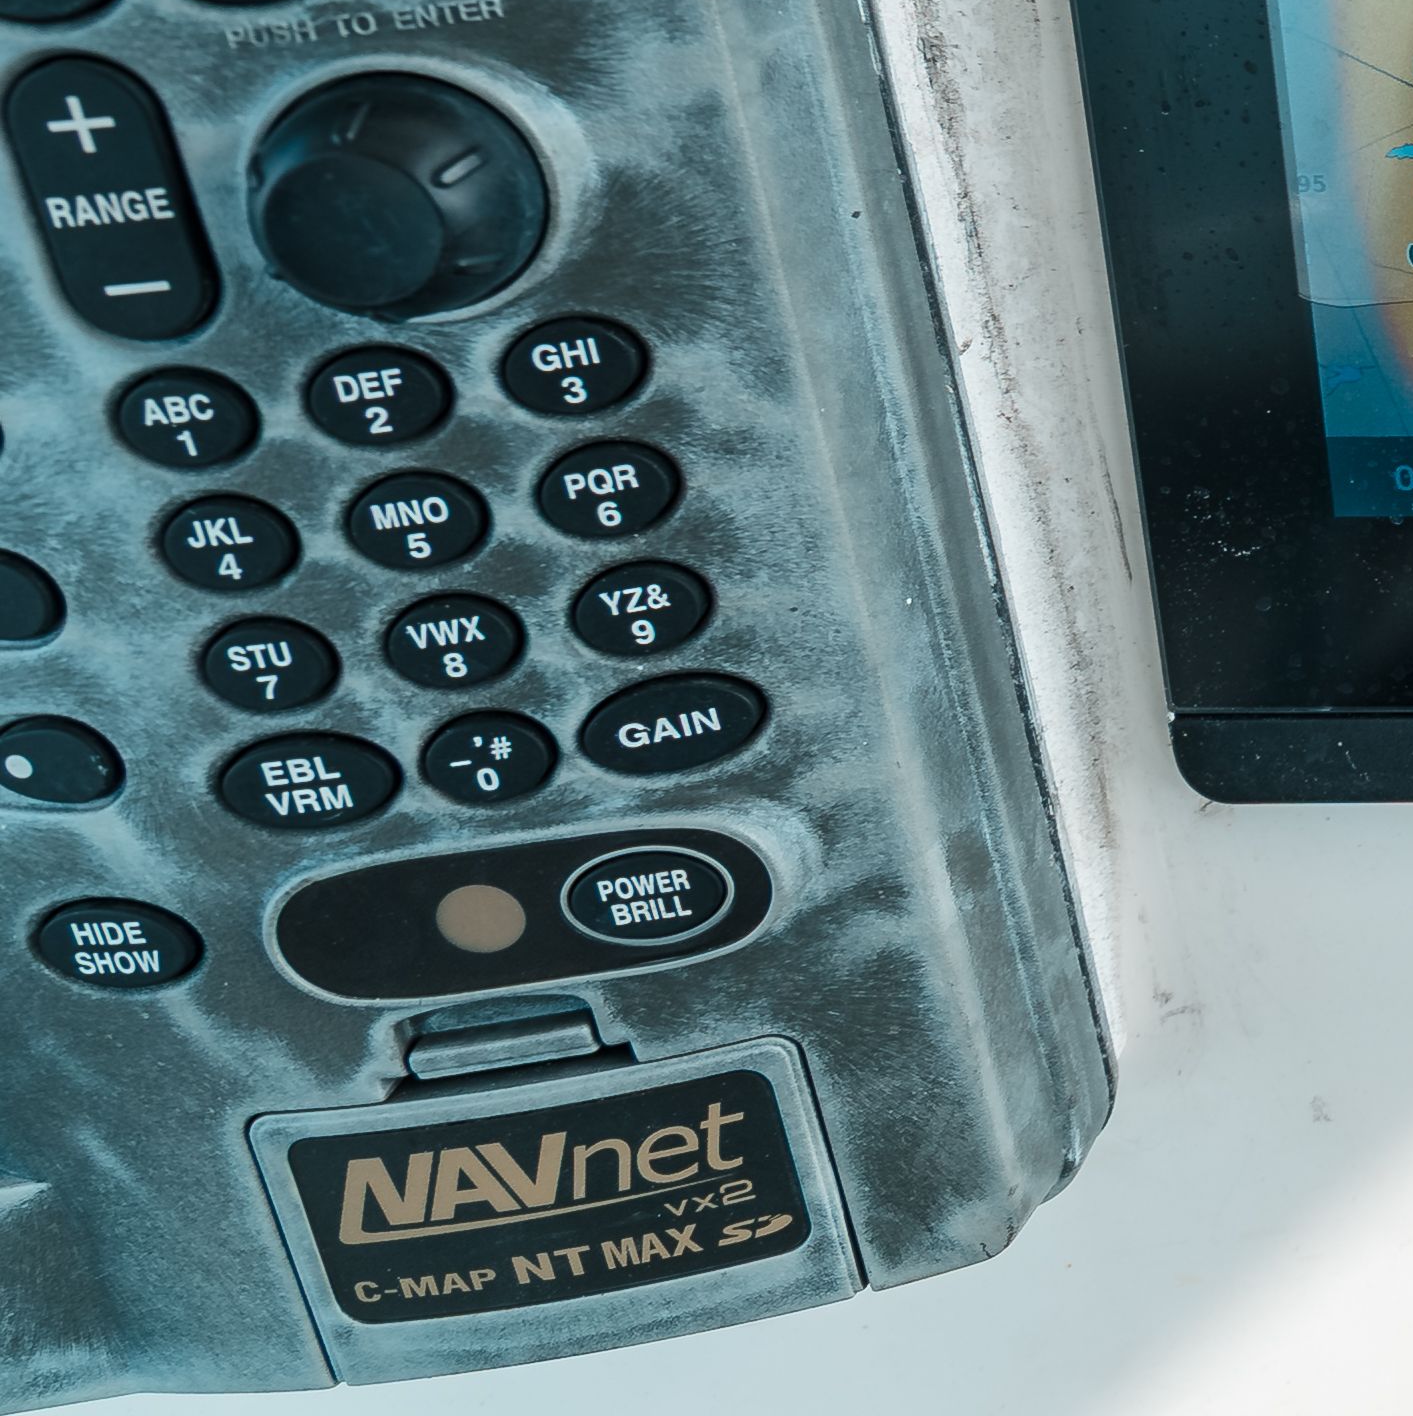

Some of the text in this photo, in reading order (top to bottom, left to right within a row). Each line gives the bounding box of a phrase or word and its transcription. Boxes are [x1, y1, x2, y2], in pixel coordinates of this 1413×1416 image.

[226, 21, 315, 48] PUSH
[336, 13, 376, 37] TO
[46, 189, 174, 229] RANGE
[532, 338, 601, 372] GHI
[333, 369, 402, 403] DEF
[562, 376, 588, 405] 3
[144, 395, 214, 427] ABC
[366, 407, 392, 435] 2
[178, 431, 199, 458] 1
[564, 464, 639, 500] PQR
[371, 496, 449, 531] MNO
[598, 501, 622, 528] 6
[188, 518, 253, 549] JKL
[408, 532, 432, 559] 5
[218, 554, 242, 580] 4
[600, 584, 671, 615] YZ&
[406, 616, 485, 650] VWX
[631, 620, 656, 645] 9
[228, 642, 292, 673] STU
[442, 653, 468, 678] 8
[256, 675, 278, 701] 7
[617, 707, 723, 749] GAIN
[261, 755, 342, 787] EBL
[476, 766, 500, 792] 0
[266, 784, 354, 818] VRM
[597, 870, 691, 902] POWER
[611, 893, 693, 928] BRILL
[72, 921, 147, 948] HIDE
[75, 948, 161, 976] SHOW
[339, 1101, 745, 1245] NAVnet
[354, 1224, 704, 1304] C-MAP NT MAX
